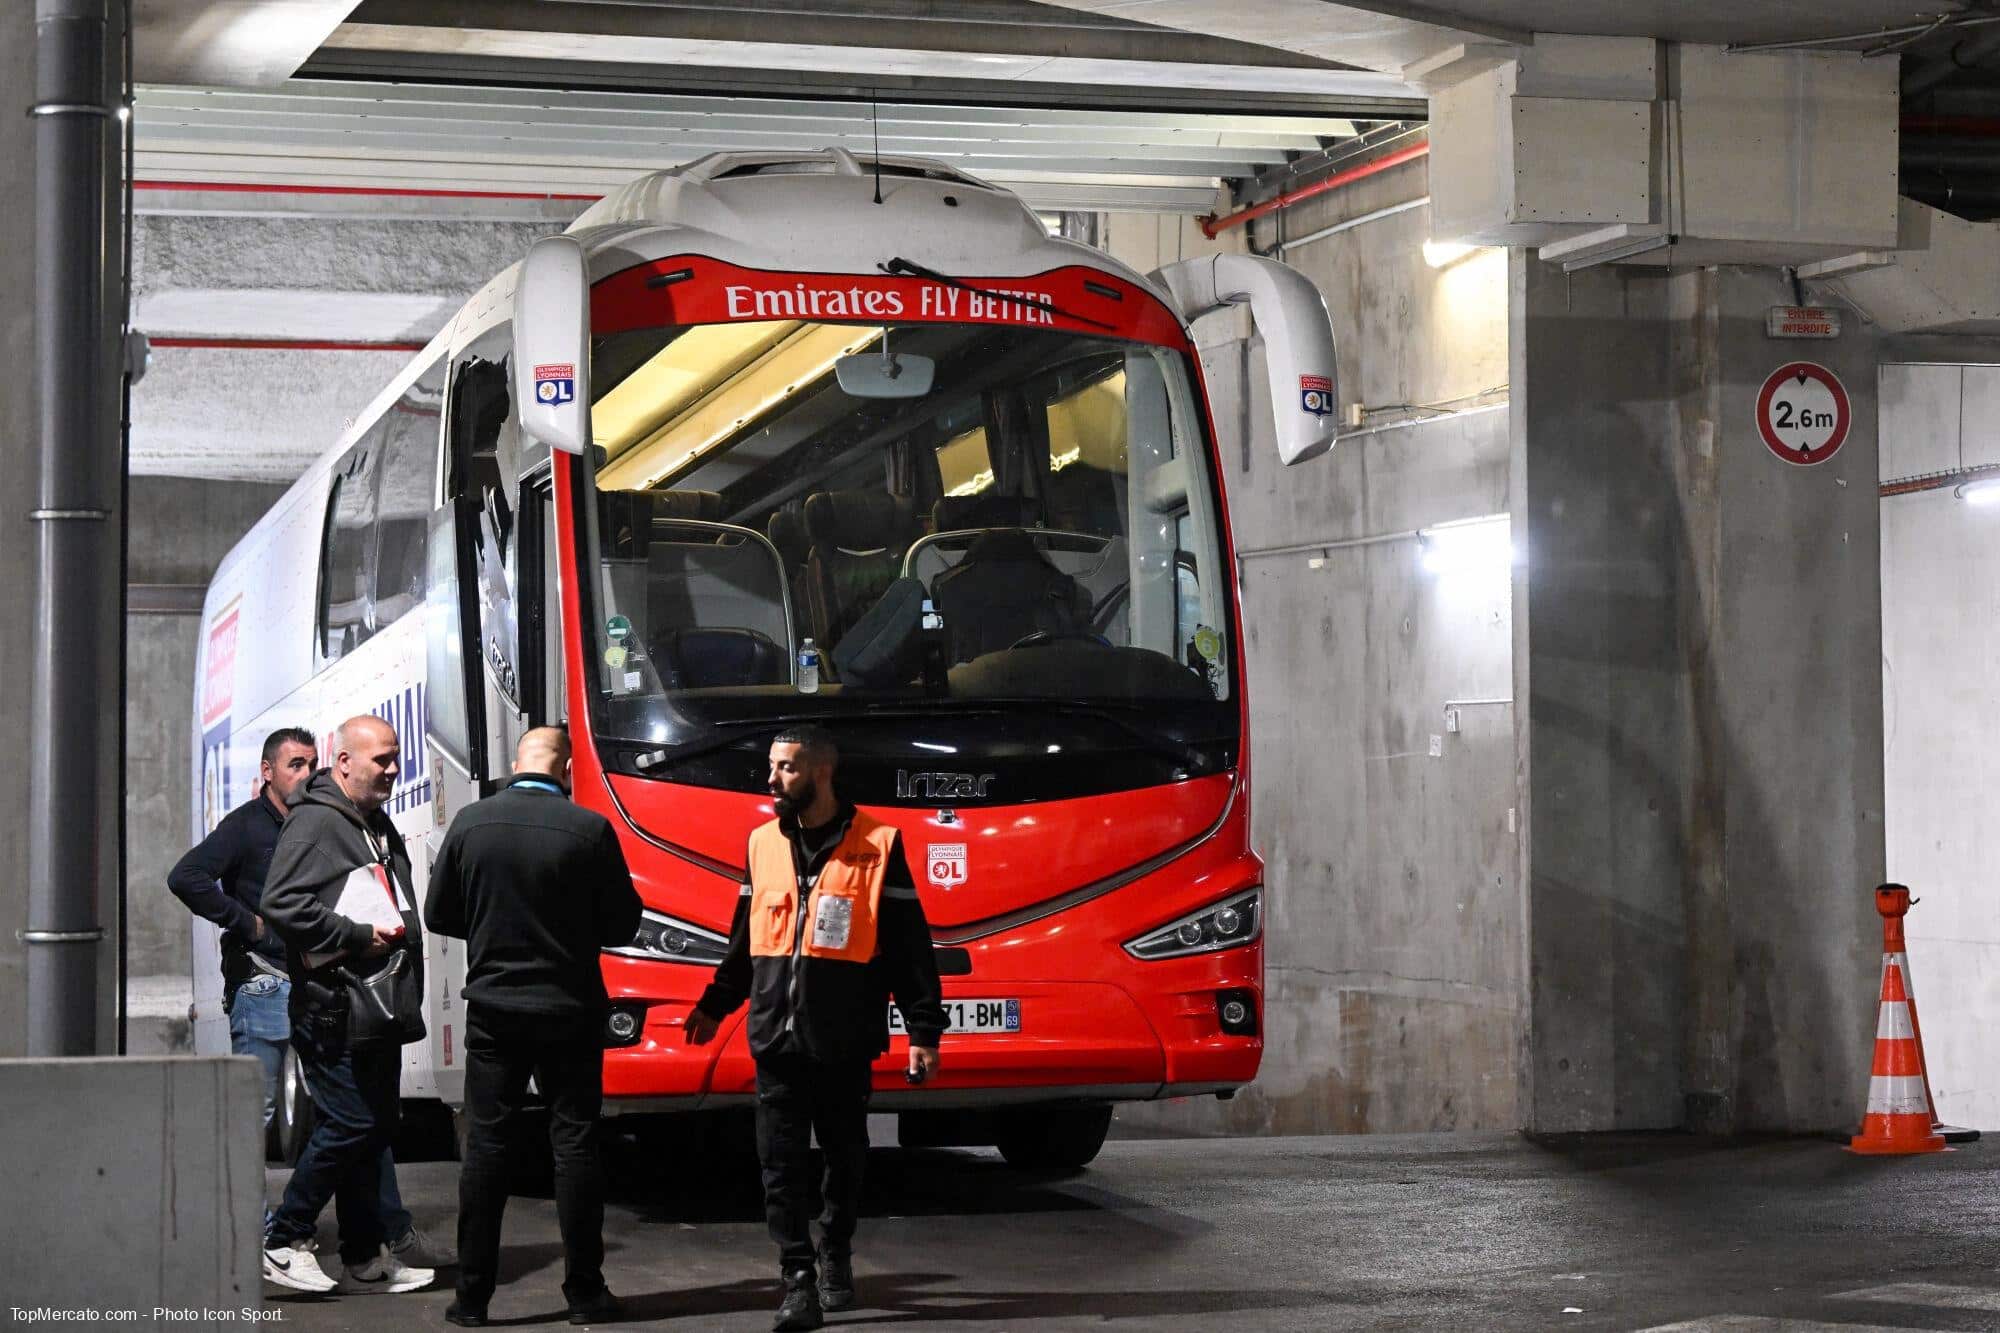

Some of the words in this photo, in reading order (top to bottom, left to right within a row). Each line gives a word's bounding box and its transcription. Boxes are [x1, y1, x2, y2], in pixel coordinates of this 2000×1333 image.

[725, 283, 904, 317] Emirates
[921, 286, 960, 317] FLY
[969, 288, 1054, 325] BETTER
[1781, 323, 1832, 335] INTERDITE
[538, 381, 571, 401] OL
[1304, 391, 1331, 412] OL
[896, 769, 997, 798] Irizar
[932, 861, 962, 879] OL
[1006, 1015, 1018, 1026] 69
